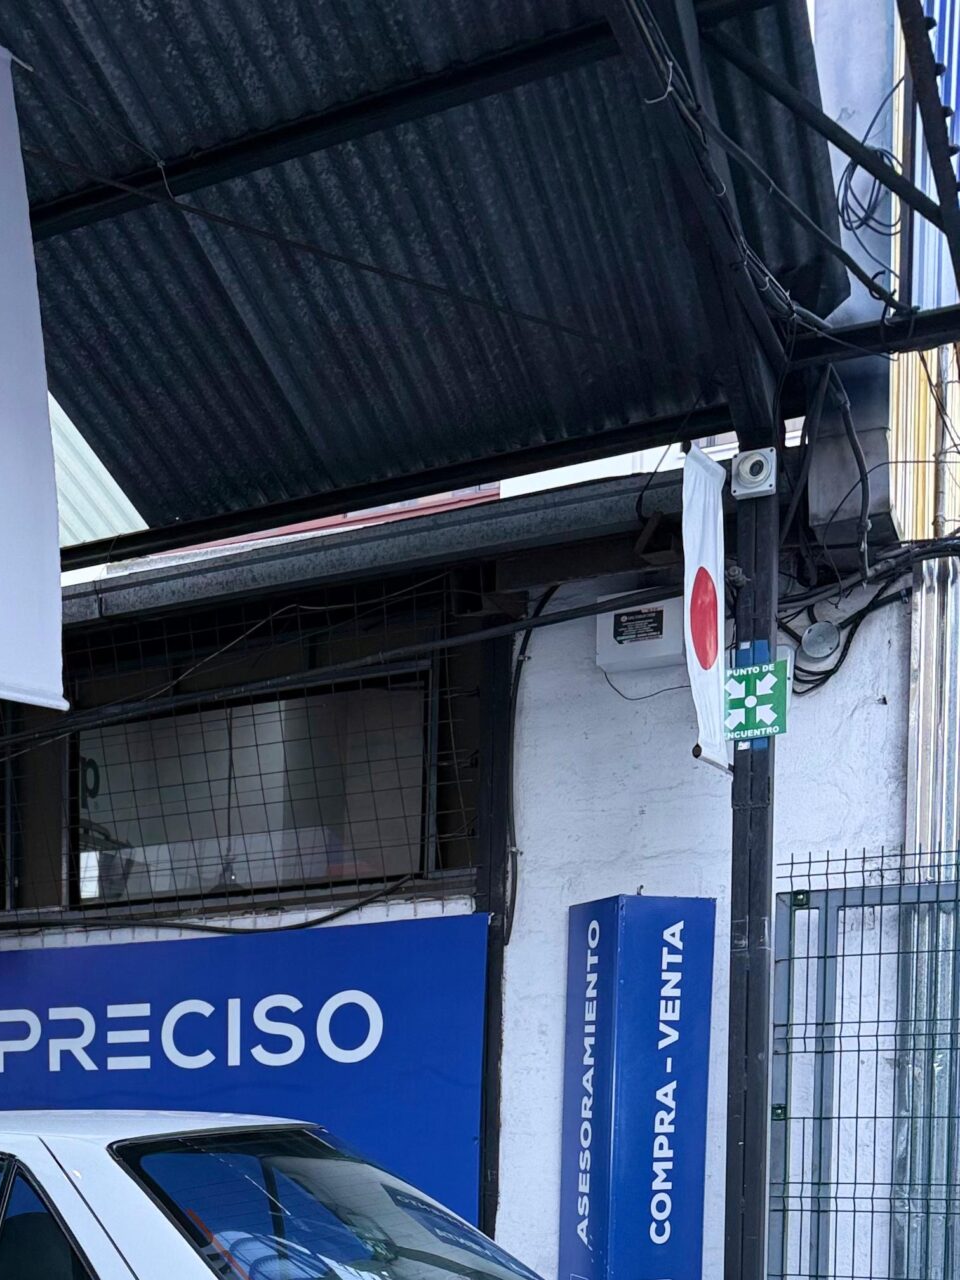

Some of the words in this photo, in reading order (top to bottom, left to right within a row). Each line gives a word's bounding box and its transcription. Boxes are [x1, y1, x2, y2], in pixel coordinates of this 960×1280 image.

[726, 666, 760, 677] PUNTO
[762, 663, 775, 672] DE
[658, 920, 685, 1050] VENTA
[576, 919, 600, 1246] ASESORAMIENTO
[649, 1080, 677, 1245] COMPRA
